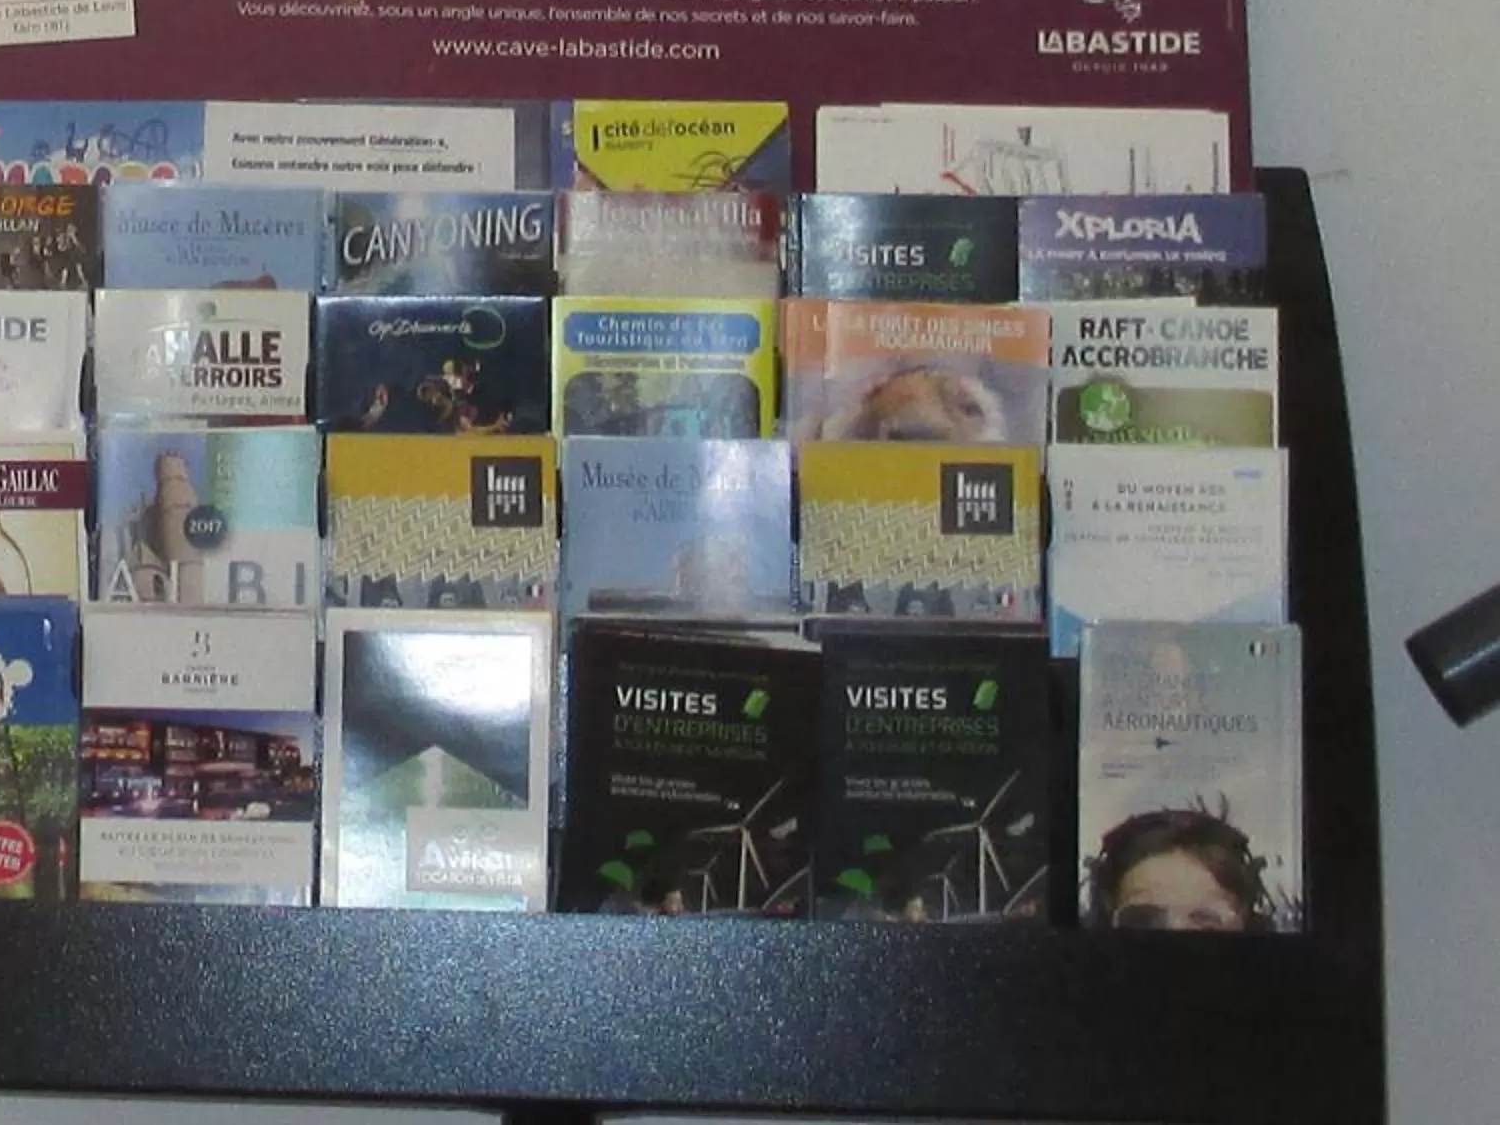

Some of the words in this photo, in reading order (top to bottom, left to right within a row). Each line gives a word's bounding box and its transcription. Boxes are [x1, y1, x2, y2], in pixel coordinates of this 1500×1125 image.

[236, 0, 276, 16] Vous
[377, 5, 414, 18] sous
[417, 6, 439, 18] un
[441, 4, 485, 22] angle
[634, 6, 658, 23] de
[660, 10, 689, 23] nos
[691, 8, 748, 24] secrets
[751, 10, 768, 24] et
[771, 9, 793, 24] de
[796, 12, 825, 25] nos
[431, 37, 721, 60] www.cave-labastide.com
[1037, 30, 1202, 55] LABASTIDE
[343, 202, 542, 265] CANYONING
[1054, 209, 1203, 245] XPLORIA
[1061, 345, 1269, 370] ACCROBRANCHE
[188, 519, 223, 534] 2017
[615, 684, 719, 716] VISITES
[845, 683, 949, 712] VISITES
